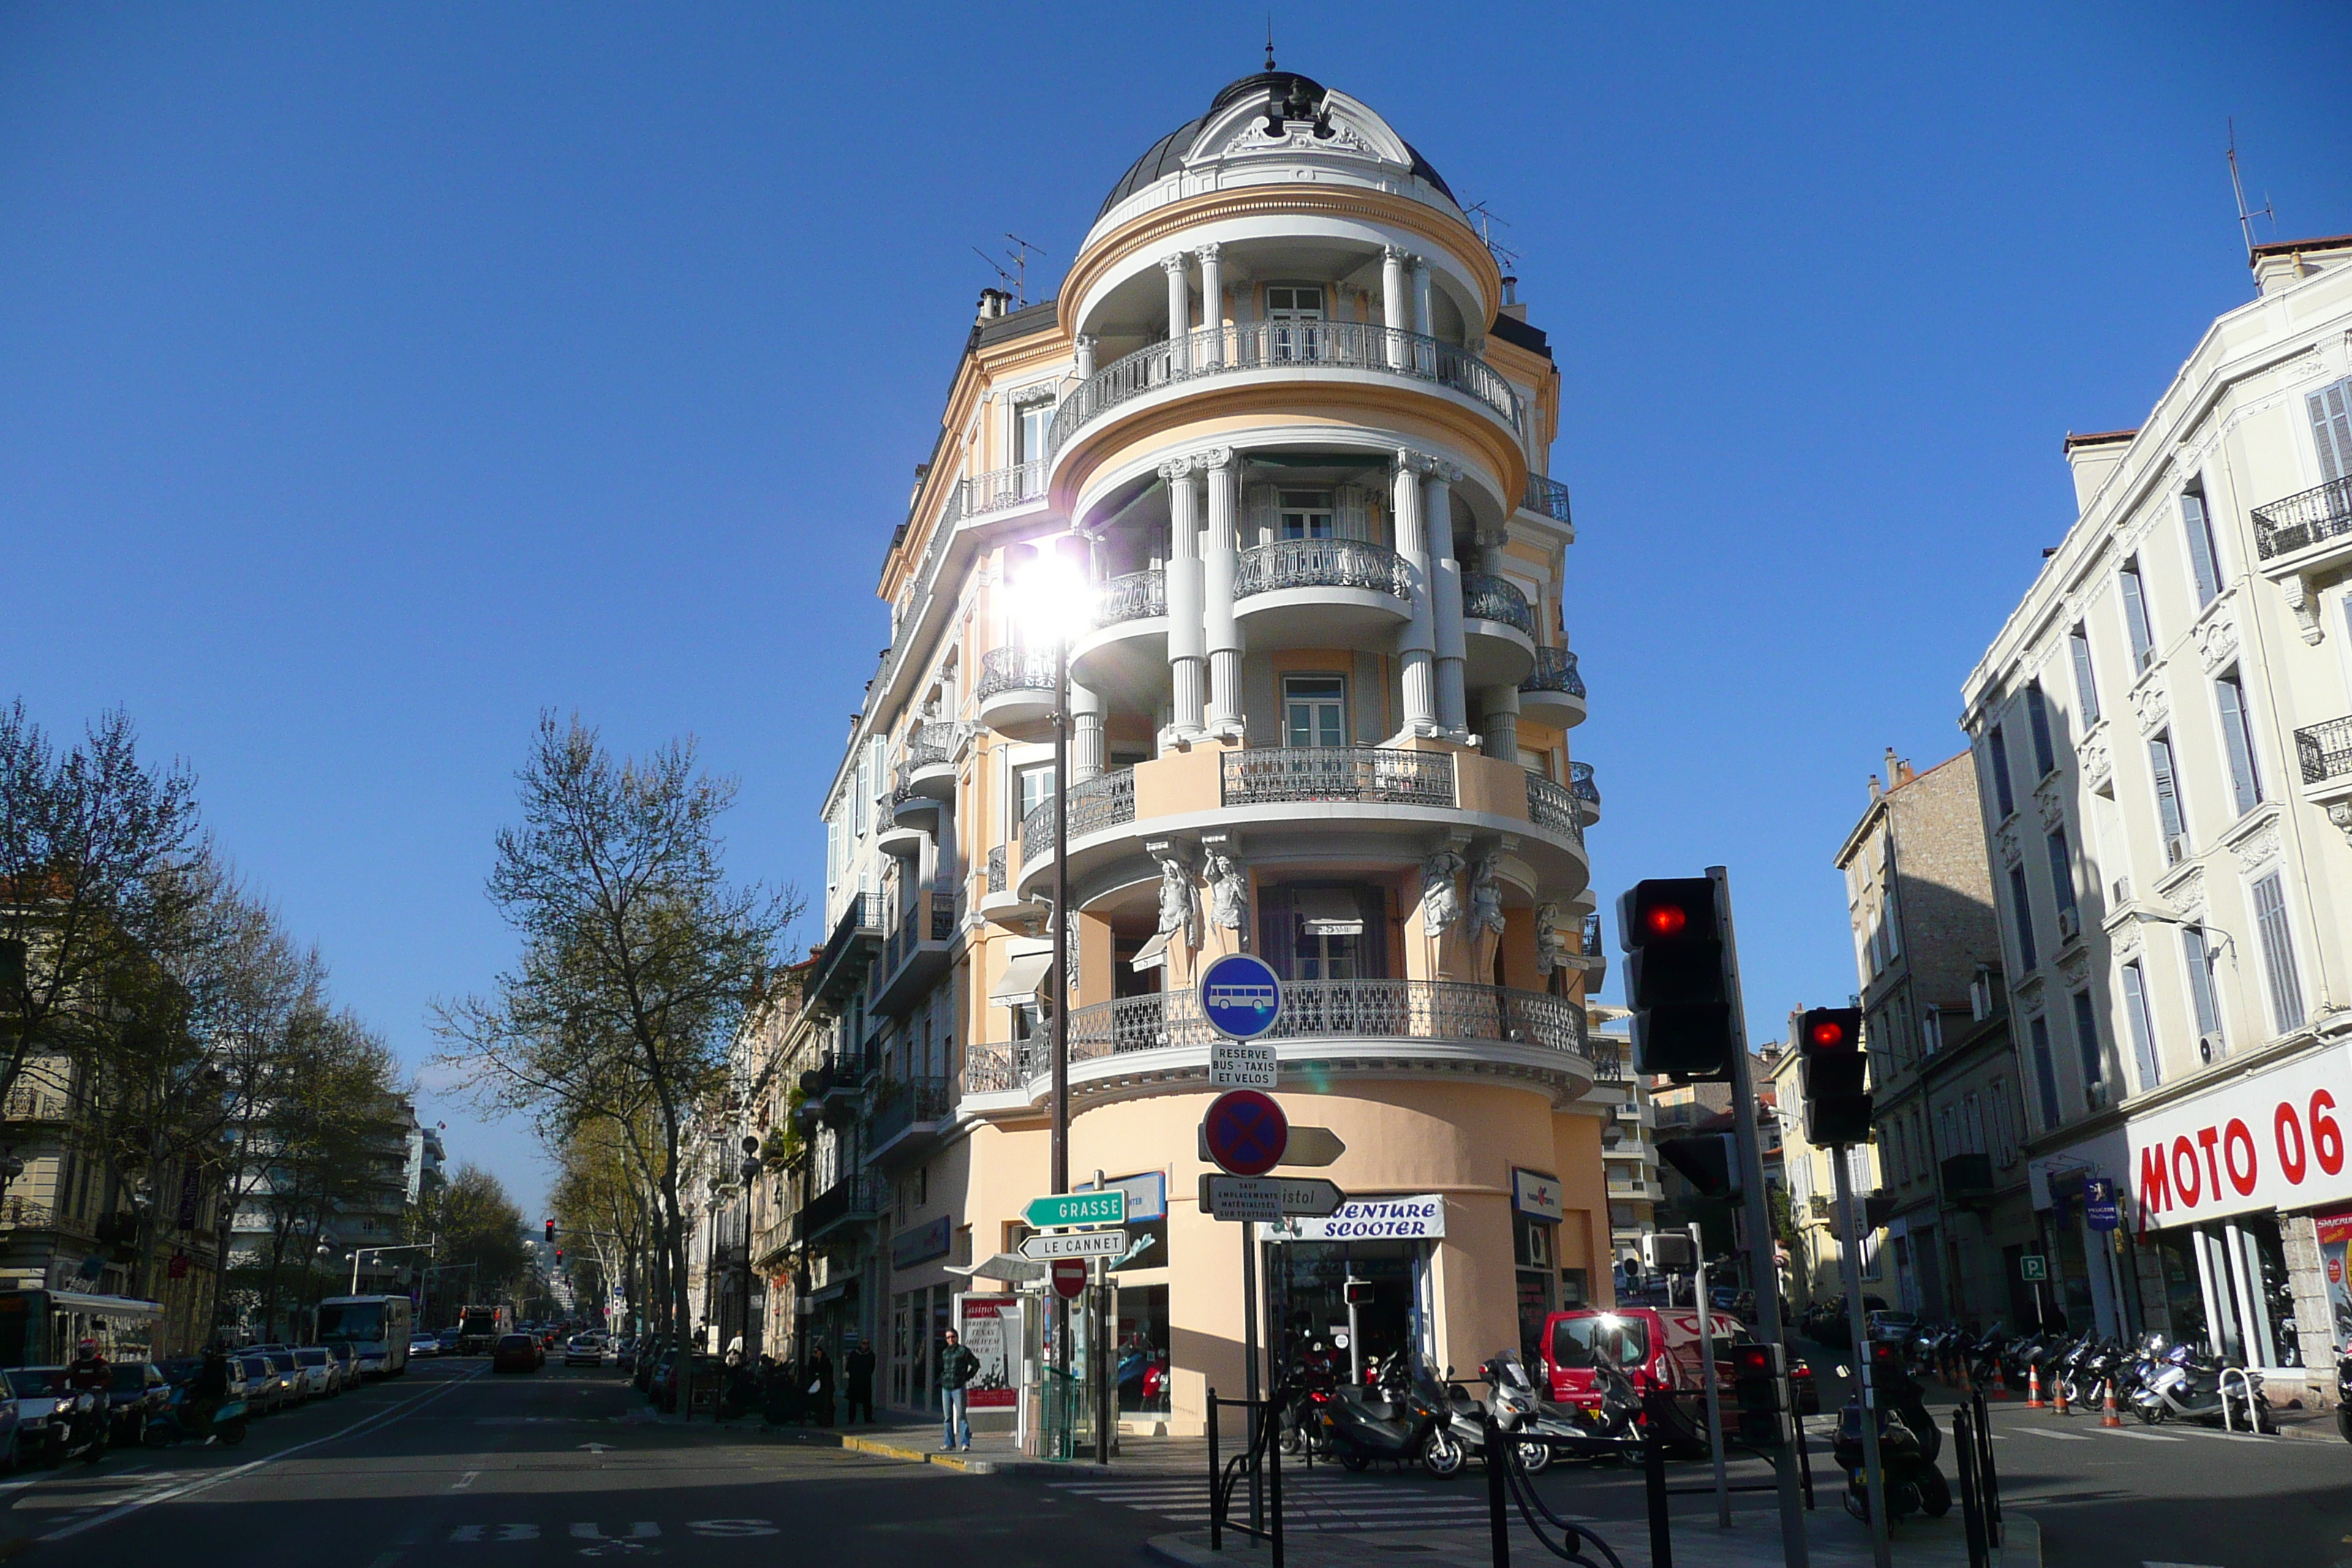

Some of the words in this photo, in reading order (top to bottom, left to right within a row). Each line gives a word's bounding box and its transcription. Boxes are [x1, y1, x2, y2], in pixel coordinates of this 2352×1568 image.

[1219, 1049, 1268, 1059] RESERVE
[1213, 1060, 1234, 1070] BUS
[1245, 1062, 1275, 1071] TAXIS
[1219, 1073, 1231, 1082] ET
[1235, 1073, 1269, 1083] VELOS
[2138, 1117, 2258, 1245] MOTO
[2274, 1088, 2344, 1186] 06
[1282, 1189, 1315, 1204] istol
[1059, 1199, 1119, 1218] GRASSE
[1332, 1203, 1436, 1218] VENTURE
[1324, 1221, 1426, 1237] SCOOTER
[1044, 1242, 1059, 1253] LE
[1066, 1237, 1119, 1251] CANNET
[2027, 1260, 2038, 1275] P
